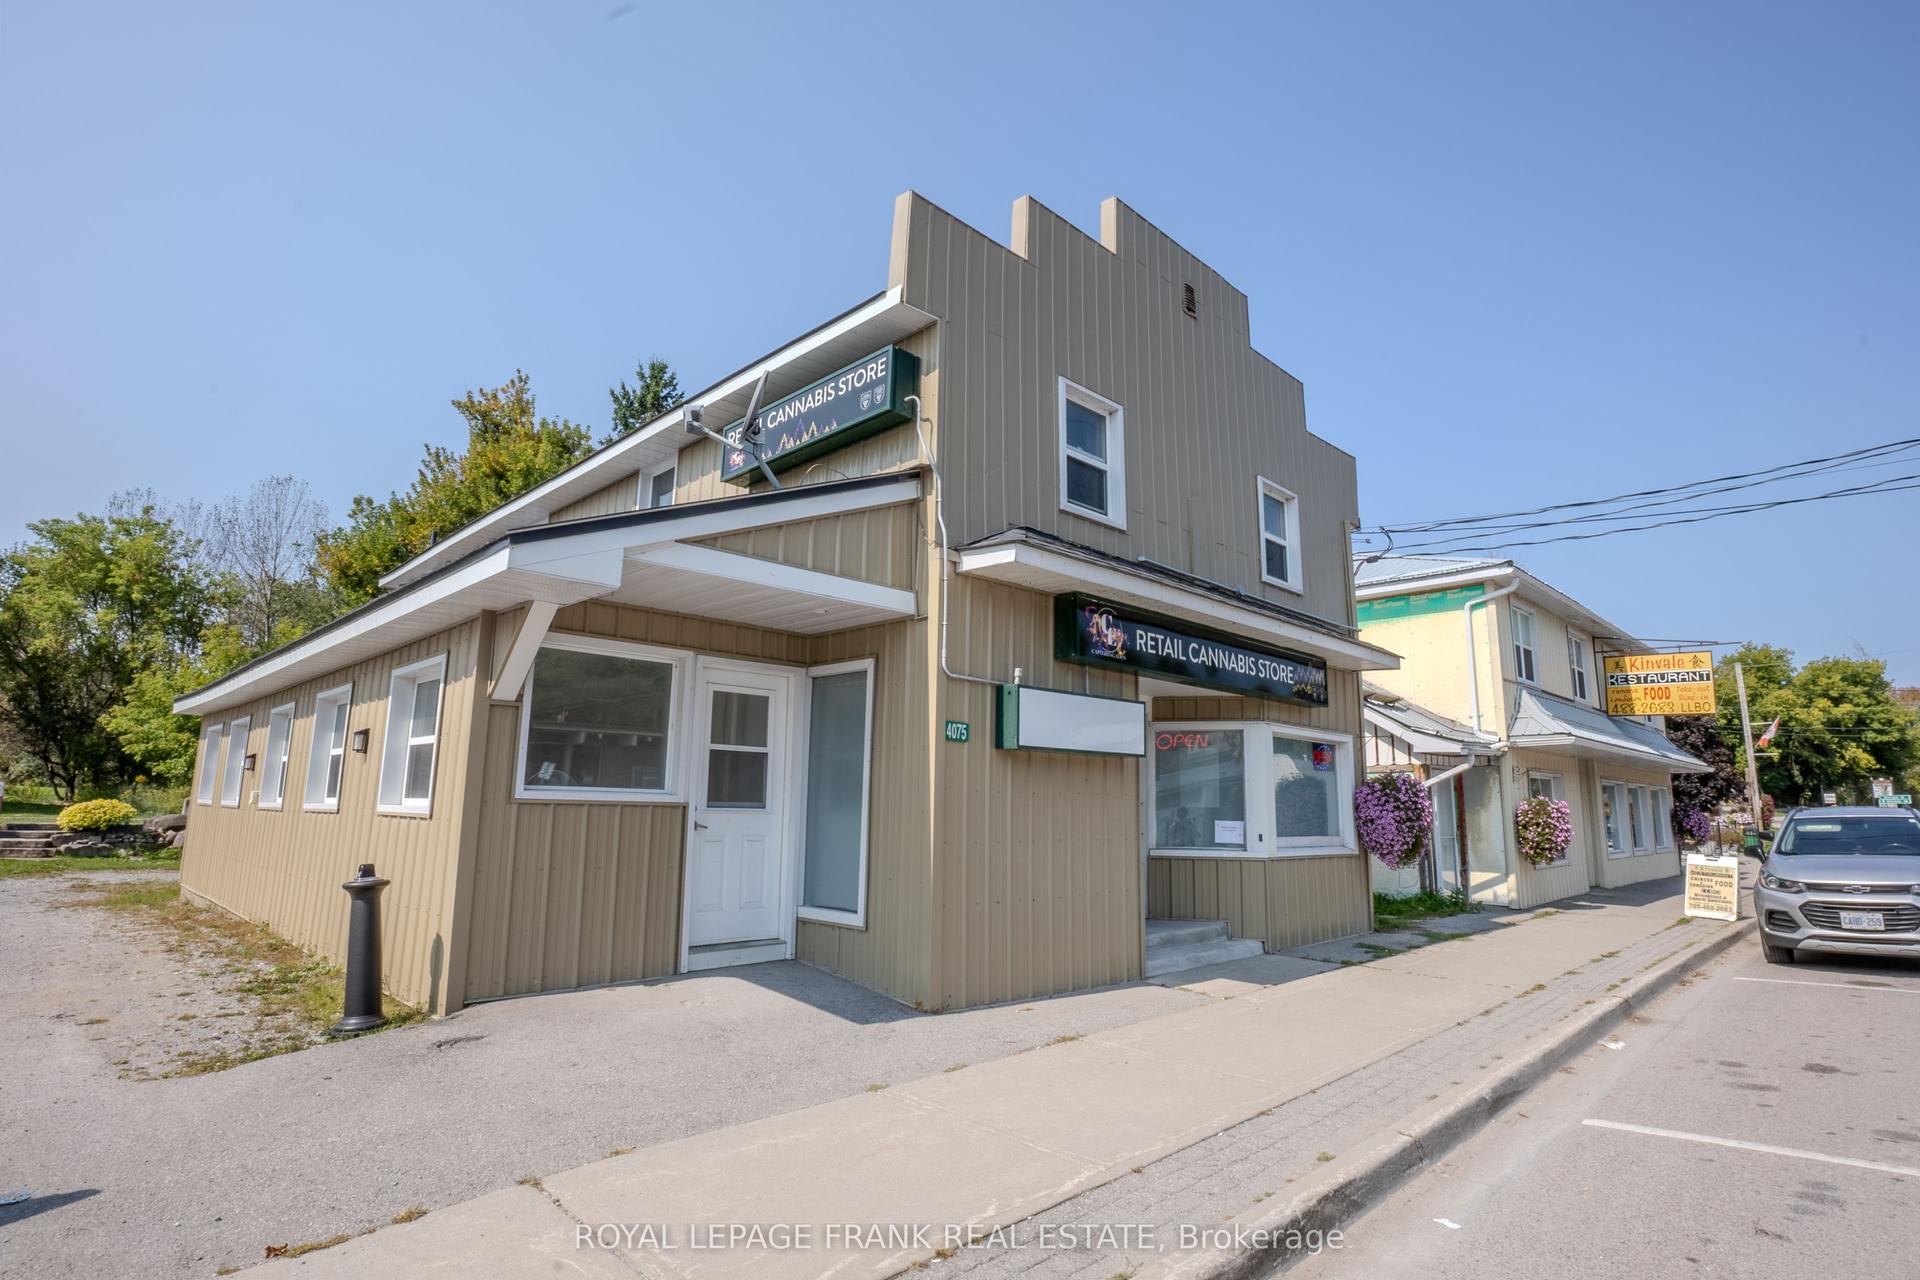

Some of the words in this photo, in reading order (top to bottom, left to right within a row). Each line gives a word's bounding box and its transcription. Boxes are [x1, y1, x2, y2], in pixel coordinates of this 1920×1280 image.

[767, 383, 835, 428] CANNABIS
[838, 357, 887, 395] STORE
[1136, 629, 1187, 660] RETAIL
[1189, 642, 1256, 676] CANNABIS
[1258, 659, 1295, 684] STORE
[1629, 655, 1685, 672] Kinvale
[1608, 671, 1709, 686] RESTAURANT
[1643, 687, 1671, 700] FOOD
[1611, 702, 1675, 714] 488-2683
[1680, 701, 1711, 713] LLBO
[946, 722, 967, 740] 4075
[1156, 733, 1209, 750] OPEN
